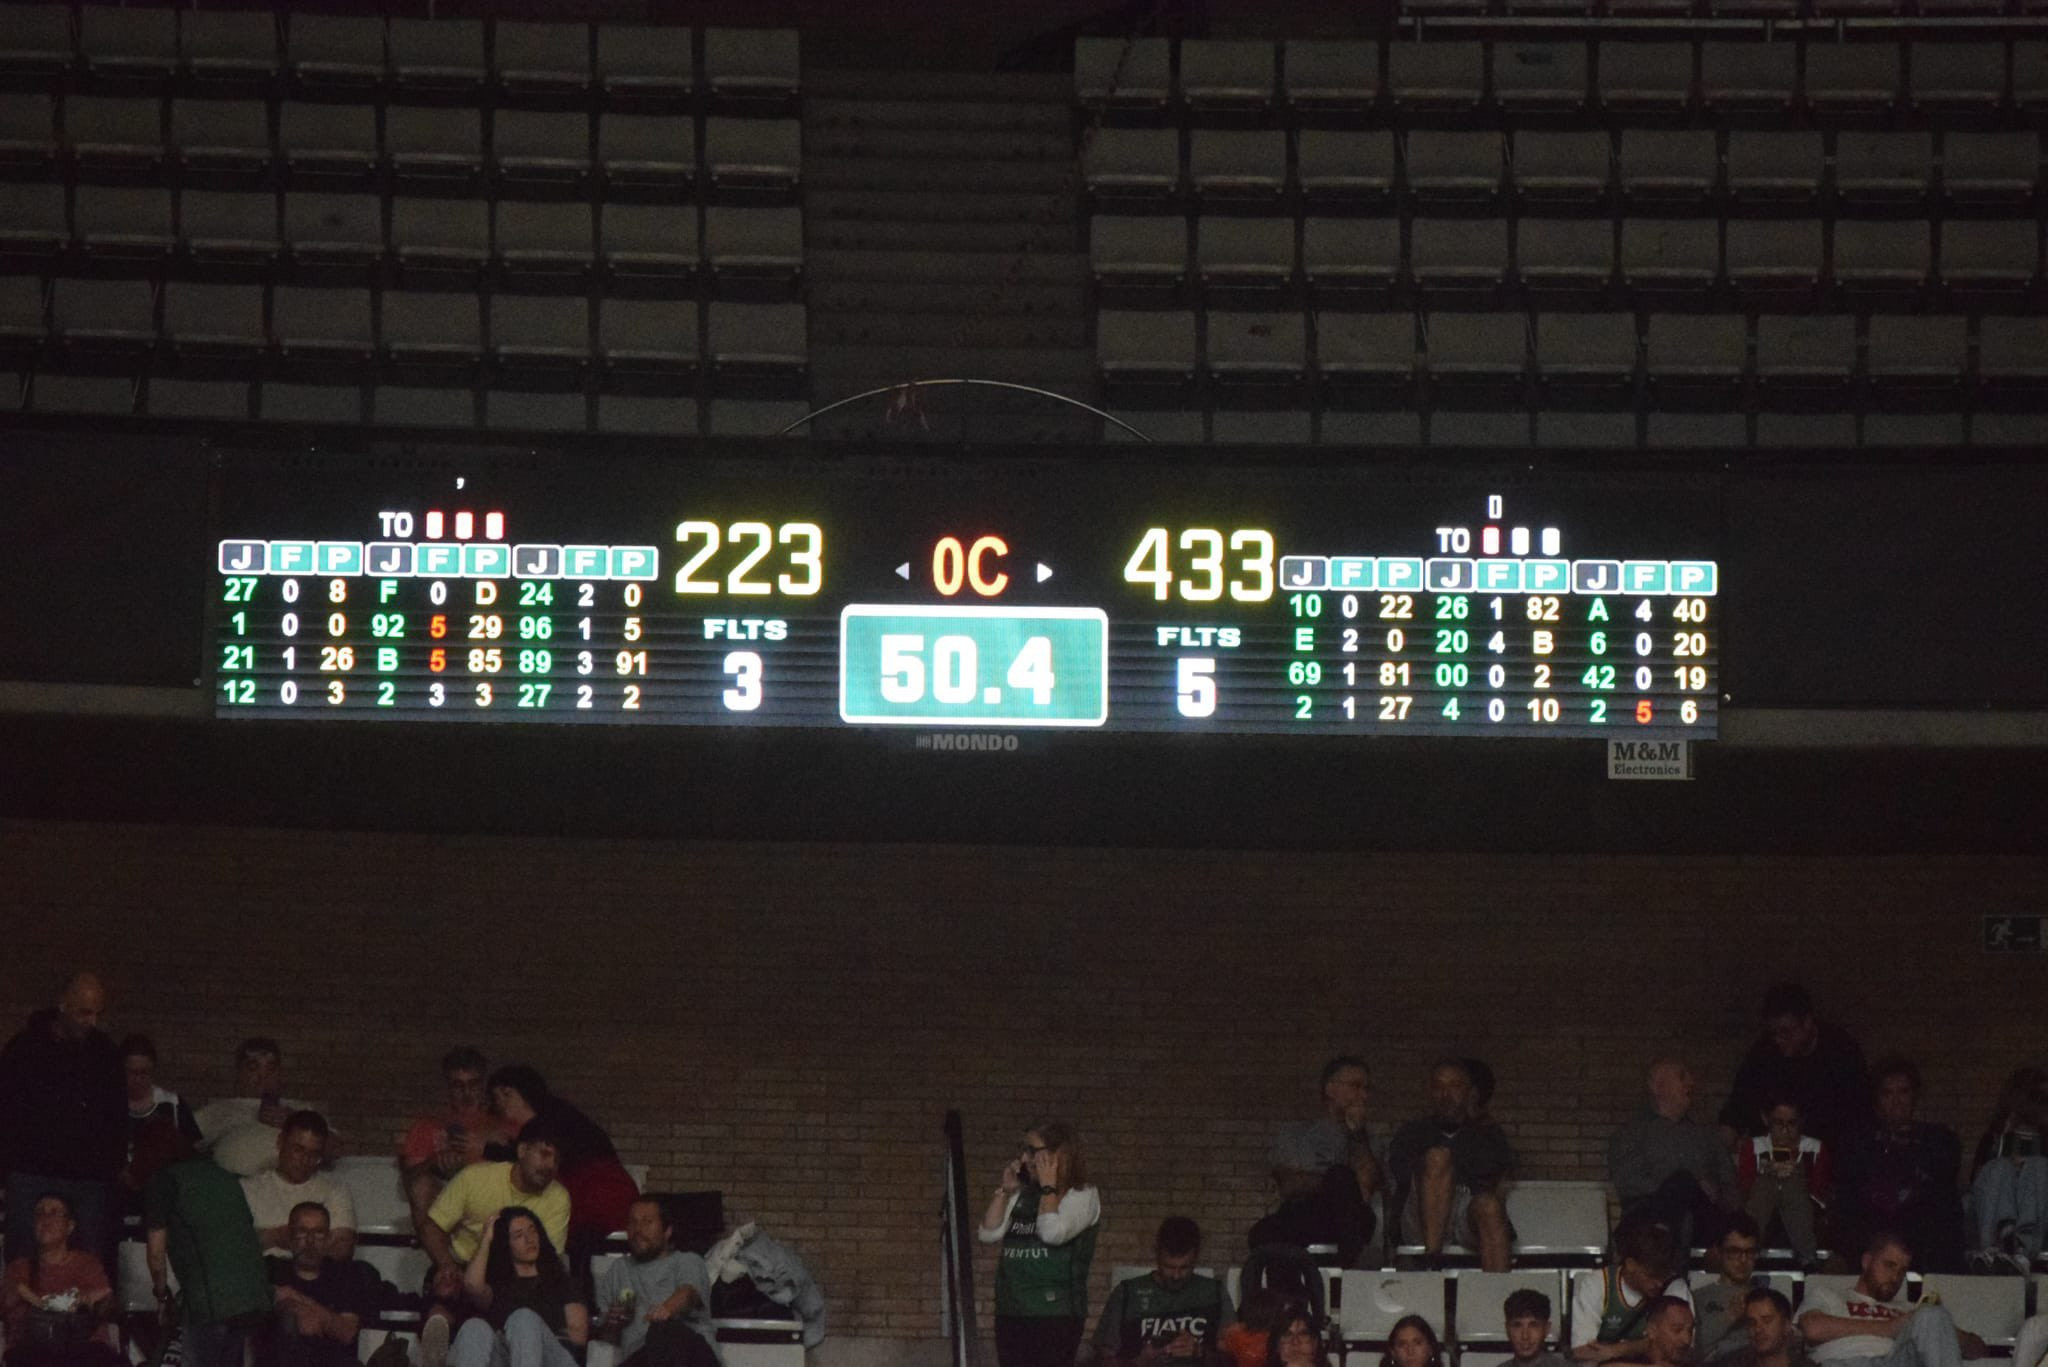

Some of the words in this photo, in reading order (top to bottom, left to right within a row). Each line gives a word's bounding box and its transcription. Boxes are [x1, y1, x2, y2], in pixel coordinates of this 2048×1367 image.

[378, 511, 414, 538] TO
[1435, 527, 1471, 554] TO
[231, 546, 251, 569] J
[281, 546, 302, 569] F
[328, 547, 351, 570] P
[380, 548, 401, 571] J
[428, 548, 449, 571] F
[476, 549, 498, 572] P
[527, 550, 547, 574] J
[575, 551, 596, 573] F
[622, 552, 645, 574] P
[675, 520, 823, 596] 223
[1123, 527, 1275, 603] 433
[1292, 561, 1312, 585] J
[1342, 562, 1362, 585] F
[1389, 563, 1411, 586] P
[1440, 563, 1461, 587] J
[1488, 564, 1509, 587] F
[1535, 565, 1558, 587] P
[1587, 565, 1607, 589] J
[1635, 566, 1655, 589] F
[1682, 567, 1704, 590] P
[224, 578, 258, 601] 27
[282, 579, 299, 603] 0
[329, 579, 346, 603] 8
[380, 580, 397, 603] F
[430, 581, 446, 605] 0
[476, 581, 497, 605] D
[519, 582, 553, 605] 24
[578, 583, 594, 606] 2
[624, 583, 642, 607] 0
[1290, 594, 1321, 617] 10
[1342, 594, 1358, 618] 0
[1379, 594, 1412, 618] 22
[1436, 596, 1468, 619] 26
[1490, 597, 1502, 620] 1
[1527, 596, 1559, 620] 82
[1588, 598, 1609, 621] A
[1635, 599, 1652, 622] 4
[1673, 599, 1706, 622] 40
[233, 612, 244, 635] 1
[282, 613, 298, 636] 0
[329, 613, 346, 636] 0
[372, 614, 404, 637] 92
[431, 615, 446, 638] 5
[468, 615, 503, 638] 29
[519, 616, 552, 639] 96
[579, 617, 590, 640] 1
[624, 617, 642, 641] 5
[703, 618, 788, 641] FLTS
[1156, 626, 1241, 648] FLTS
[1296, 627, 1313, 651] E
[1342, 629, 1358, 652] 2
[1387, 629, 1404, 652] 0
[1436, 629, 1468, 653] 20
[1488, 631, 1505, 653] 4
[1533, 631, 1554, 654] B
[1590, 632, 1606, 654] 6
[1635, 633, 1652, 656] 0
[1673, 632, 1706, 656] 20
[223, 645, 253, 669] 21
[283, 647, 294, 670] 1
[320, 647, 354, 671] 26
[378, 648, 398, 671] B
[430, 648, 446, 672] 5
[468, 648, 502, 673] 85
[519, 650, 551, 674] 89
[577, 651, 593, 675] 3
[616, 651, 647, 675] 91
[880, 634, 1055, 705] 50.4
[722, 651, 763, 712] 3
[1174, 656, 1217, 719] 5
[1288, 661, 1321, 685] 69
[1343, 662, 1355, 686] 1
[1380, 662, 1409, 686] 81
[1435, 663, 1468, 687] 00
[1488, 664, 1505, 688] 0
[1533, 664, 1550, 688] 2
[1582, 665, 1615, 689] 42
[1635, 666, 1652, 690] 0
[1674, 666, 1706, 690] 19
[224, 680, 255, 703] 12
[281, 681, 297, 704] 0
[328, 681, 345, 704] 3
[377, 682, 394, 705] 2
[429, 683, 445, 707] 3
[475, 683, 492, 706] 3
[518, 684, 552, 707] 27
[577, 685, 592, 708] 2
[622, 685, 640, 709] 2
[1296, 695, 1312, 719] 2
[1342, 696, 1354, 719] 1
[1379, 696, 1412, 720] 27
[1442, 697, 1460, 720] 4
[1488, 698, 1505, 722] 0
[1527, 698, 1560, 722] 10
[1590, 699, 1606, 722] 2
[1636, 700, 1652, 724] 5
[1681, 700, 1697, 724] 6
[931, 733, 1019, 751] MONDO
[1614, 742, 1681, 760] M&M
[1614, 763, 1681, 775] Electronics
[1141, 1316, 1207, 1337] FIATC
